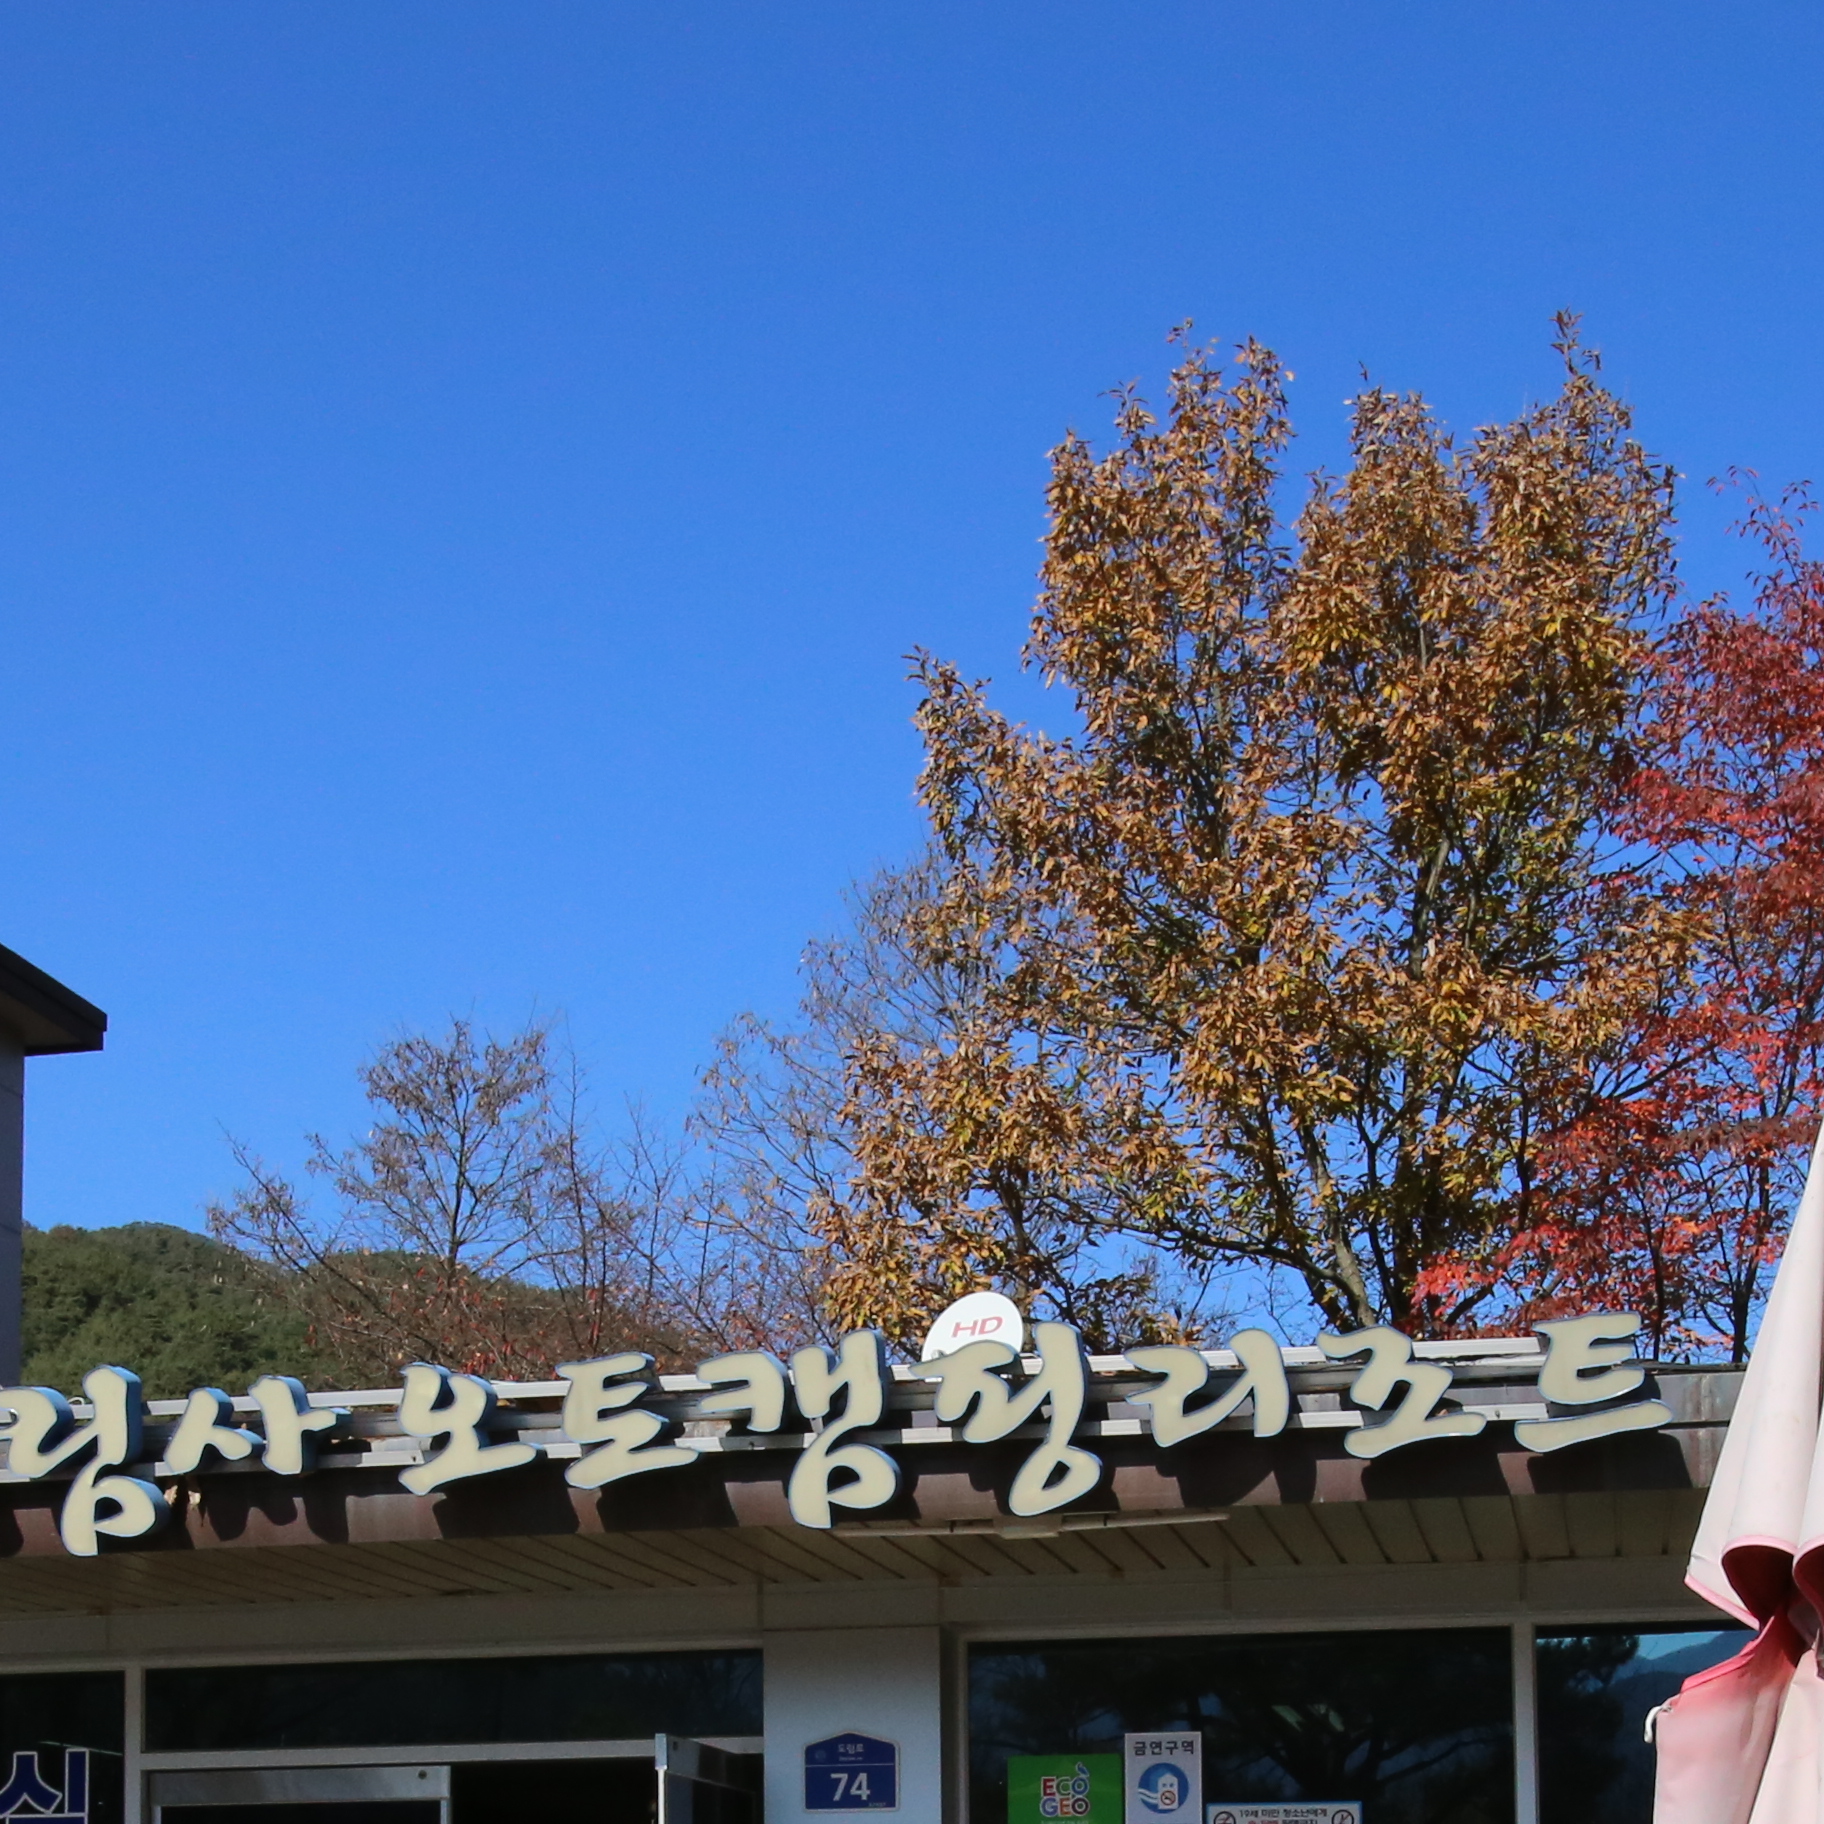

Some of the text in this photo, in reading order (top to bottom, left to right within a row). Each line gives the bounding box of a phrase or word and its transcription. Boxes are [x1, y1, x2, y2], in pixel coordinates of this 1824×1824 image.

[951, 1316, 1004, 1339] HD
[1133, 1740, 1195, 1756] 금연구역
[830, 1772, 871, 1801] 74
[1042, 1776, 1089, 1797] ECO
[1040, 1797, 1091, 1817] GEO
